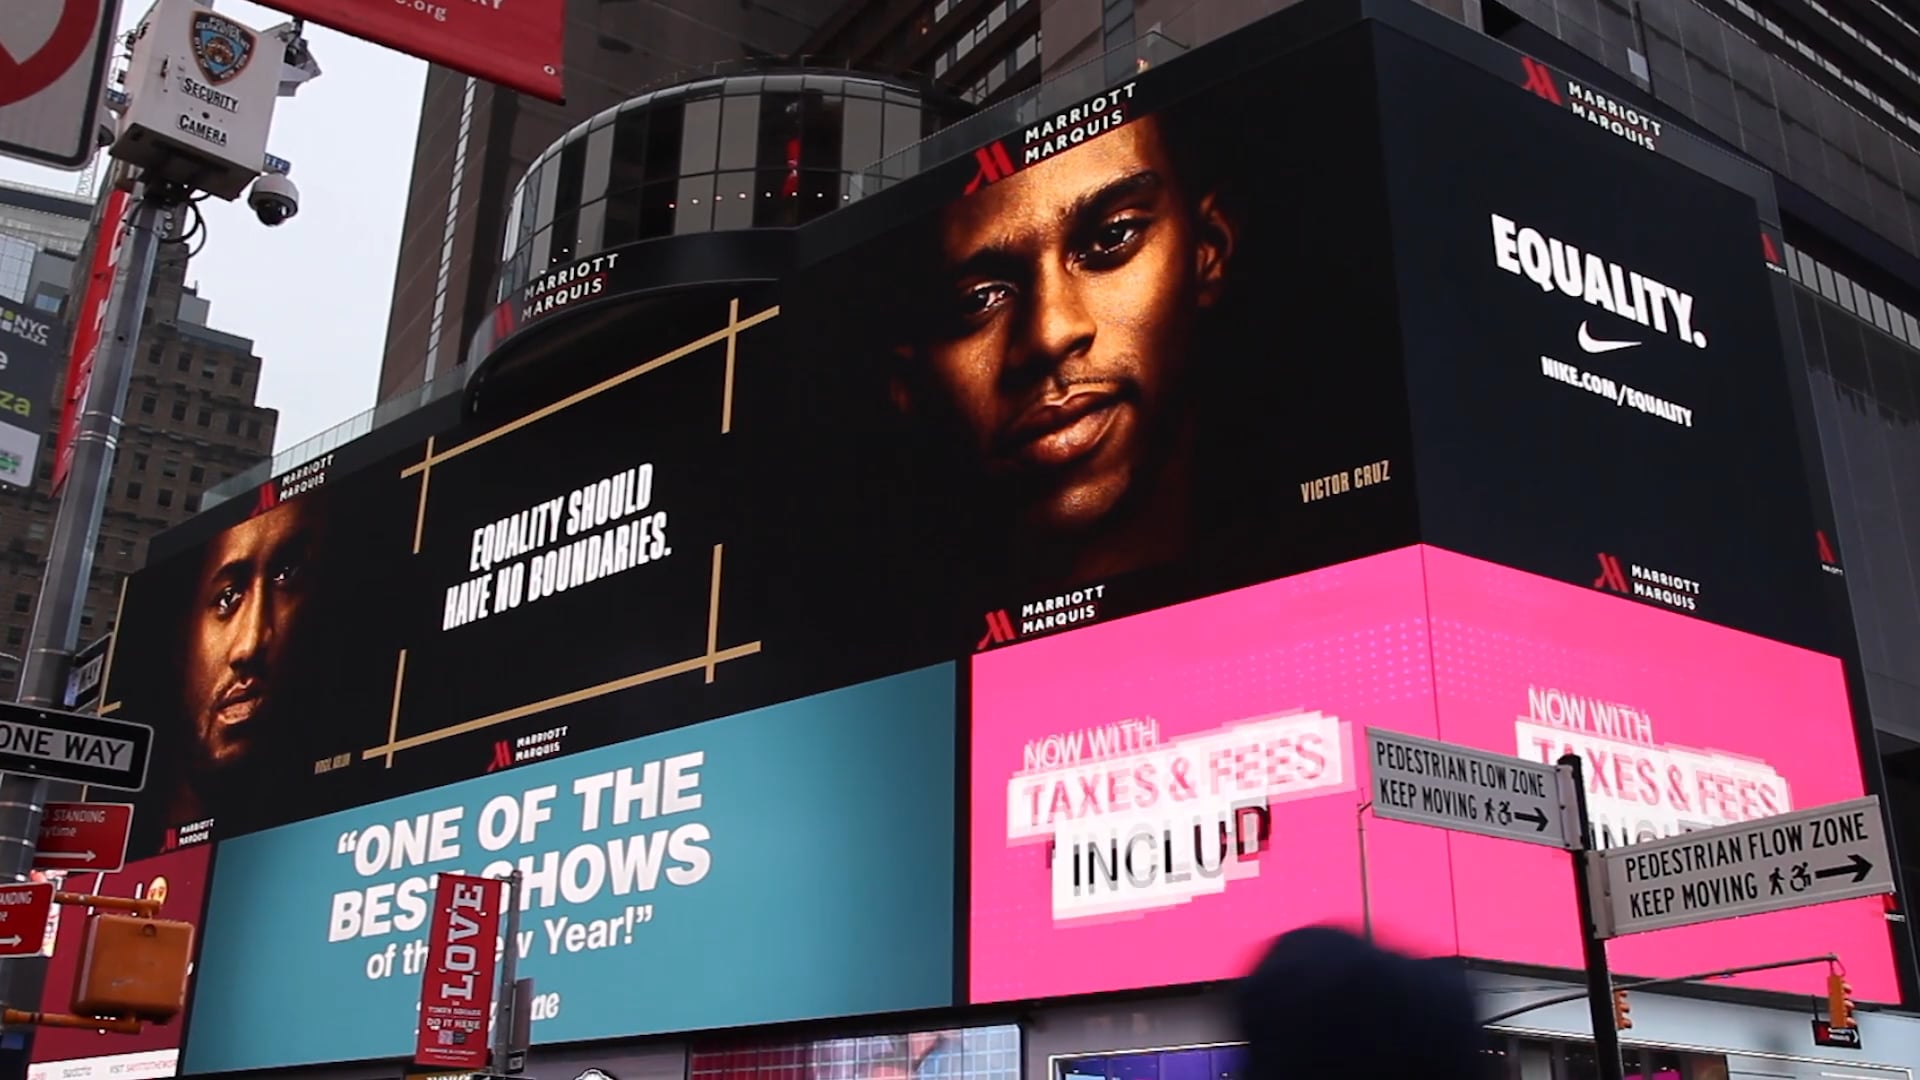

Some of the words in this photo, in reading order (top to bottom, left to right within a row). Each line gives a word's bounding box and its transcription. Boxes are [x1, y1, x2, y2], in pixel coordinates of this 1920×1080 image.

[183, 78, 239, 111] SECURITY
[1025, 82, 1136, 144] MARRIOTT
[1568, 81, 1662, 136] MARRIOTT
[179, 114, 227, 144] CAMERA
[1025, 110, 1123, 163] MARQUIS
[1571, 103, 1655, 151] MARQUIS
[524, 253, 619, 300] MARRIOTT
[1491, 213, 1707, 348] EQUALITY.
[521, 278, 602, 322] MARQUIS
[15, 315, 50, 338] NYC
[1540, 355, 1692, 427] NIKE.COM/EQUALITY
[280, 473, 325, 502] MARQUIS
[282, 454, 334, 487] MARRIOTT
[1301, 471, 1350, 503] VICTOR
[1354, 460, 1391, 489] CRUZ
[470, 496, 565, 572] EQUALITY
[566, 463, 653, 536] SHOULD
[443, 573, 492, 631] HAVE
[494, 562, 525, 614] NO
[528, 511, 672, 602] BOUNDARIES.
[1631, 564, 1700, 594] MARRIOTT
[1022, 585, 1105, 617] MARRIOTT
[1633, 582, 1696, 610] MARQUIS
[1022, 605, 1095, 633] MARQUIS
[517, 725, 568, 748] MARRIOTT
[1528, 684, 1586, 732] NOW
[1588, 698, 1654, 746] WITH
[0, 724, 54, 756] ONE
[65, 734, 126, 766] WAY
[515, 741, 560, 761] MARQUIS
[1024, 732, 1083, 771] NOW
[1088, 715, 1160, 758] WITH
[1024, 763, 1159, 826] TAXES
[1169, 757, 1197, 801] &
[1210, 733, 1326, 795] FEES
[1376, 741, 1467, 783] PEDESTRIAN
[1470, 760, 1507, 791] FLOW
[1511, 769, 1546, 798] ZONE
[1533, 737, 1660, 806] TXES
[1667, 764, 1691, 812] &
[1696, 769, 1779, 820] FEES
[53, 809, 106, 823] STANDING
[478, 785, 557, 851] OF
[574, 752, 704, 831] THE
[1379, 778, 1416, 808] KEEP
[1422, 786, 1477, 820] MOVING
[1626, 837, 1742, 883] PEDESTRIAN
[1748, 824, 1802, 861] FLOW
[1810, 812, 1868, 848] ZONE
[1630, 887, 1674, 918] KEEP
[1682, 873, 1758, 910] MOVING
[366, 942, 397, 979] of
[403, 939, 429, 975] th
[441, 884, 487, 1001] LOVE
